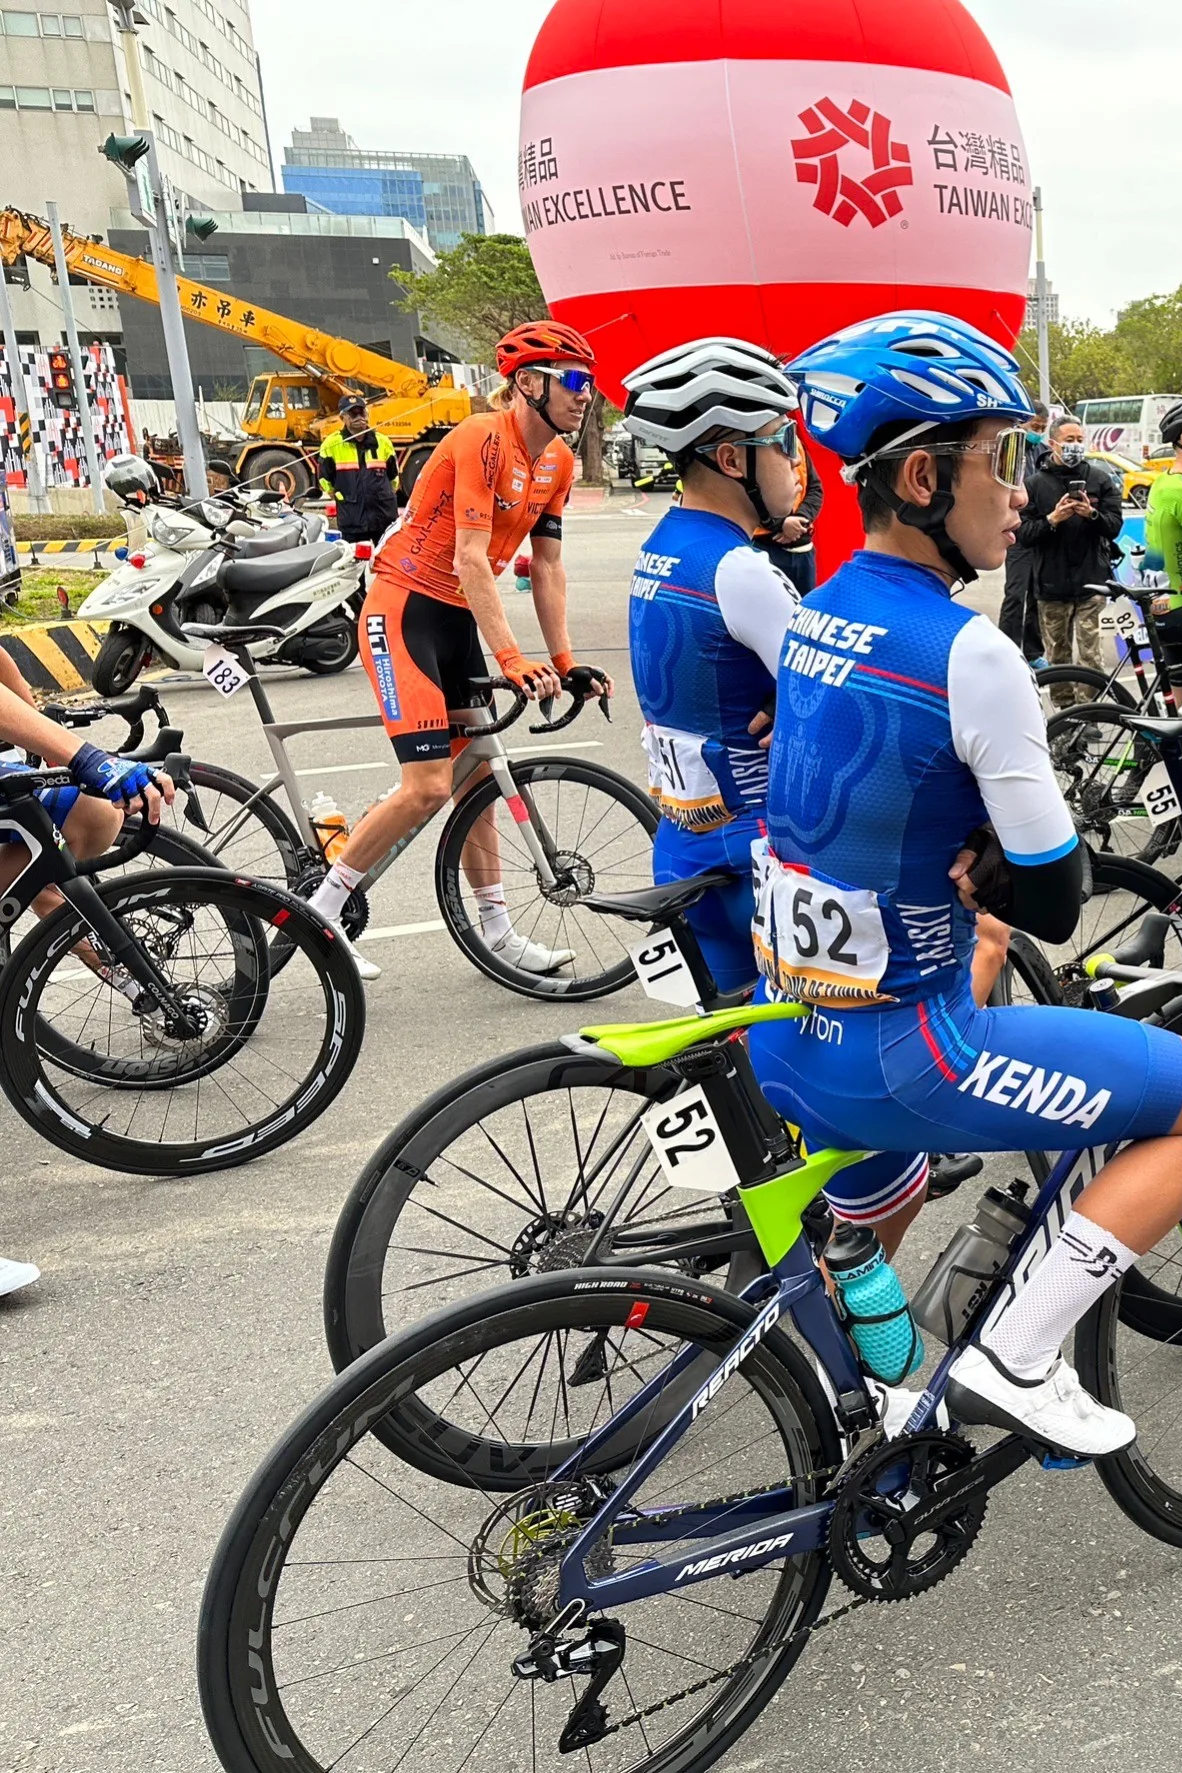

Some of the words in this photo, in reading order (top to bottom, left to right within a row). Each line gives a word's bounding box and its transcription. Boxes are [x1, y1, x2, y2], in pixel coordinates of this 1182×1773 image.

[926, 123, 1026, 187] 台灣精品
[543, 180, 692, 227] EXCELLENCE
[933, 184, 1010, 223] TAIWAN
[82, 253, 124, 277] TADANO
[788, 604, 889, 656] CHINESE
[1116, 611, 1134, 635] 82
[206, 659, 241, 694] 183
[375, 658, 388, 703] TOYOTA
[782, 639, 857, 688] TAIPEI
[382, 658, 398, 716] Hiroshima
[30, 773, 71, 790] Deda
[1145, 784, 1178, 816] 55
[791, 887, 858, 967] 52
[637, 938, 684, 984] 51
[147, 981, 180, 1020] COLNAGO
[782, 973, 810, 1000] TOUR
[957, 1049, 1113, 1130] KENDA
[655, 1099, 717, 1169] 52
[574, 1281, 599, 1290] HIGH
[599, 1281, 629, 1289] ROAD
[689, 1303, 781, 1421] REACTO
[674, 1532, 795, 1583] MERIDA
